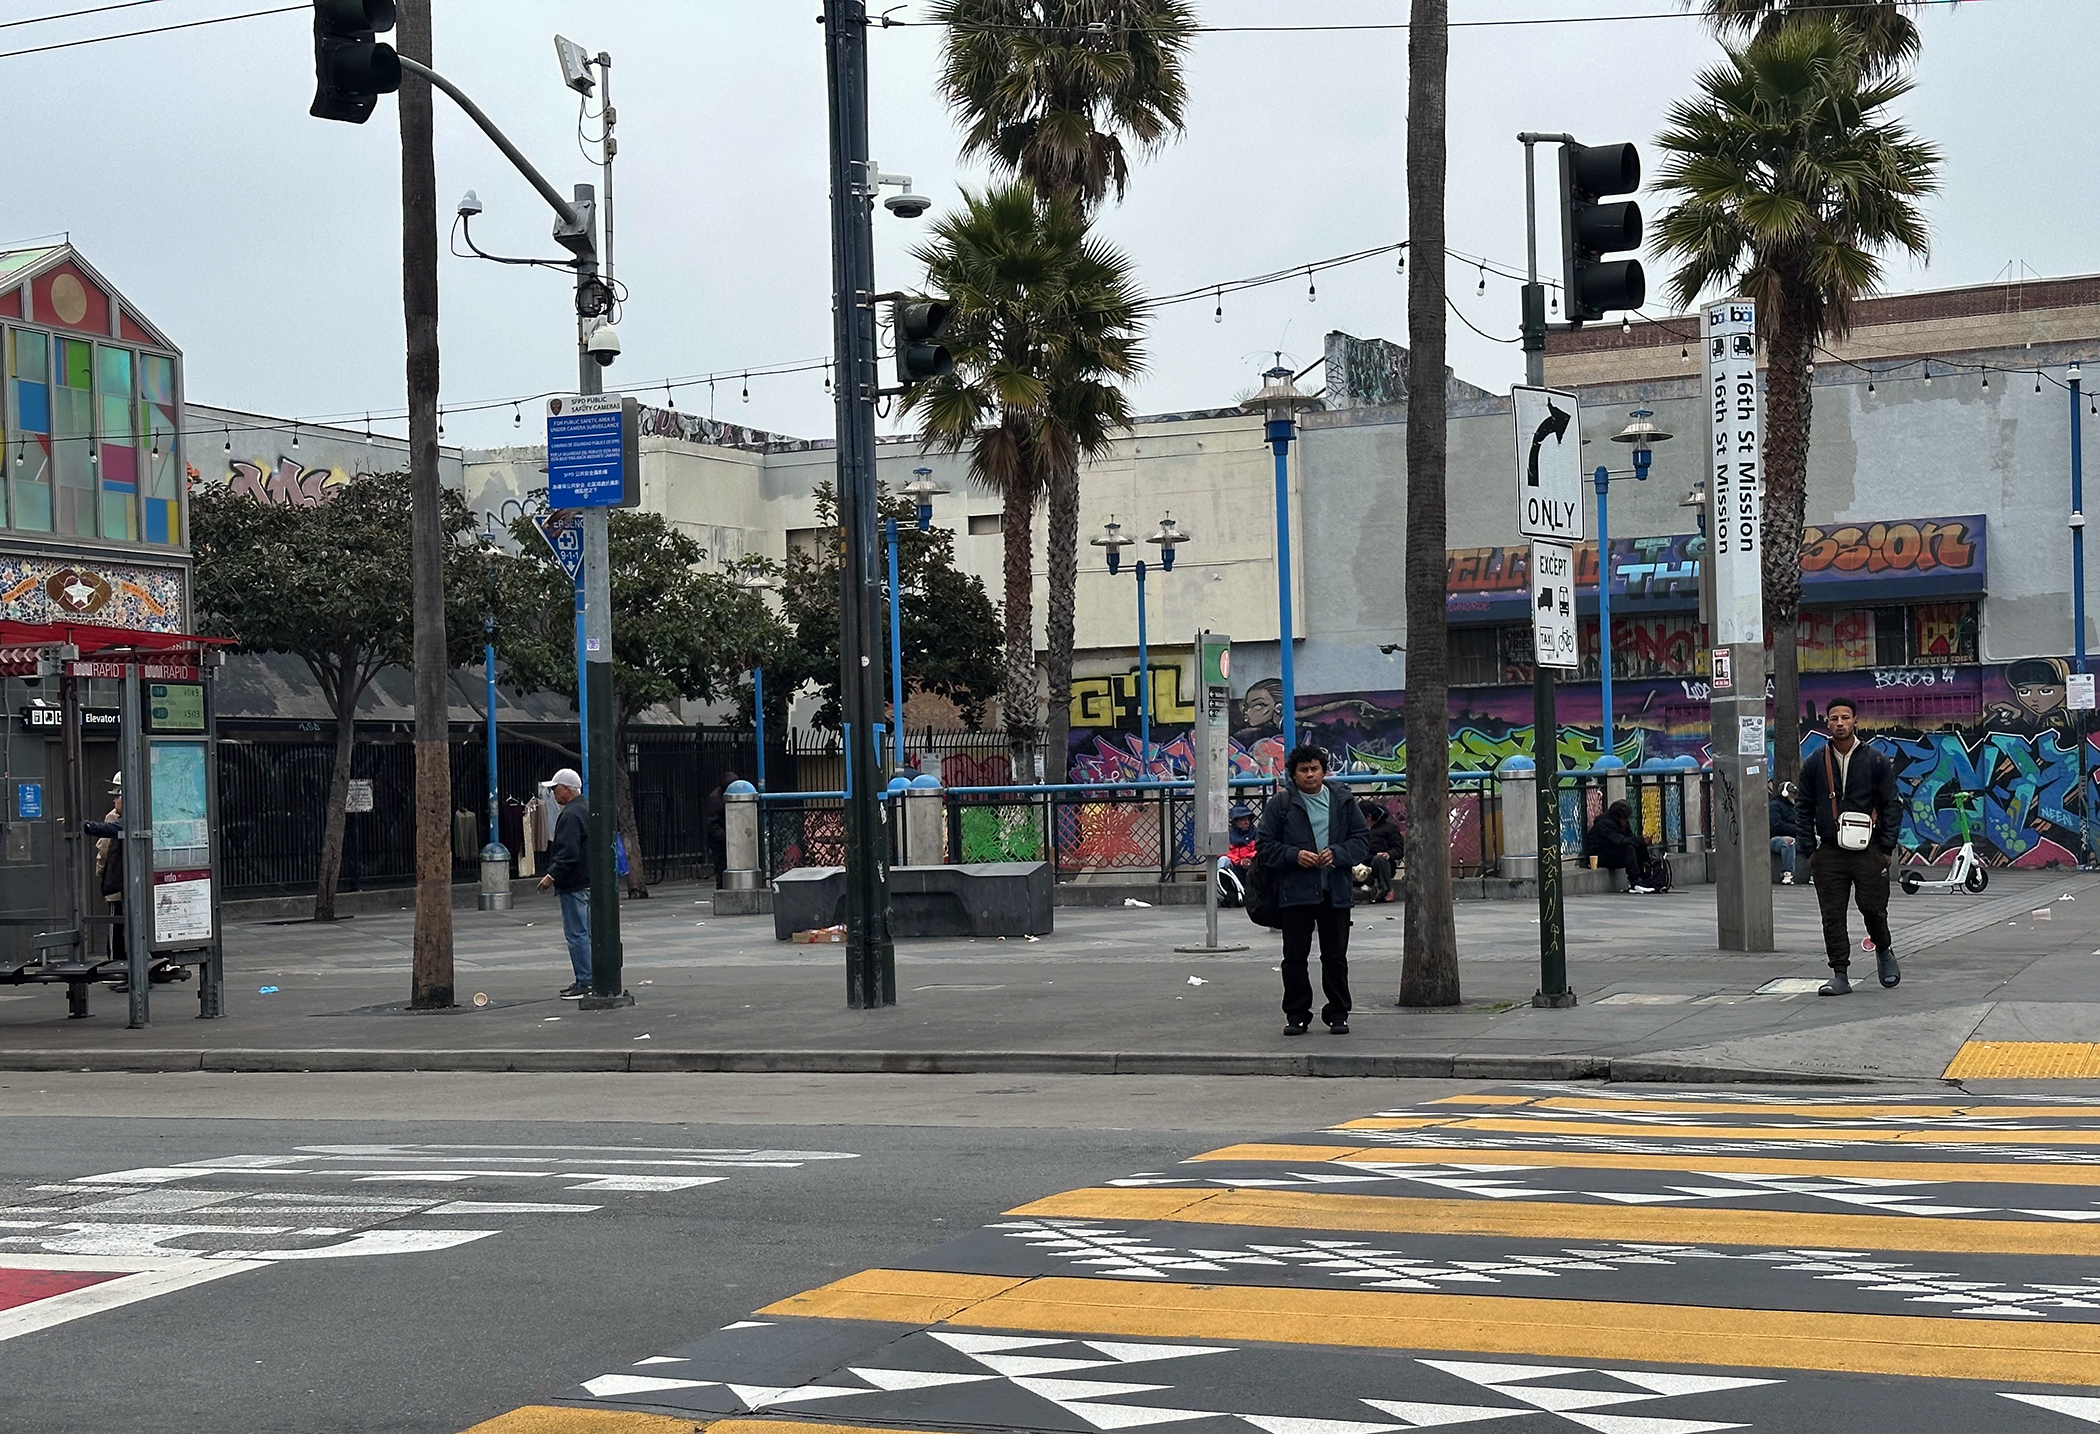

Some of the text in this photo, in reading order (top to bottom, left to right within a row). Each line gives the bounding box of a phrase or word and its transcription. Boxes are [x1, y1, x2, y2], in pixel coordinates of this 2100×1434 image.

[571, 403, 621, 413] SAFETY CAMERAS
[1715, 372, 1730, 554] 16th St Mission
[1736, 371, 1757, 552] 16th St Mission
[1528, 497, 1575, 530] ONLY
[1539, 554, 1568, 578] EXCEPT
[1540, 632, 1552, 645] TAXI
[1913, 655, 1948, 665] CHICKEN
[93, 663, 120, 678] RAPID
[163, 665, 188, 680] RAPID
[85, 713, 112, 723] Elevator
[164, 872, 177, 882] info
